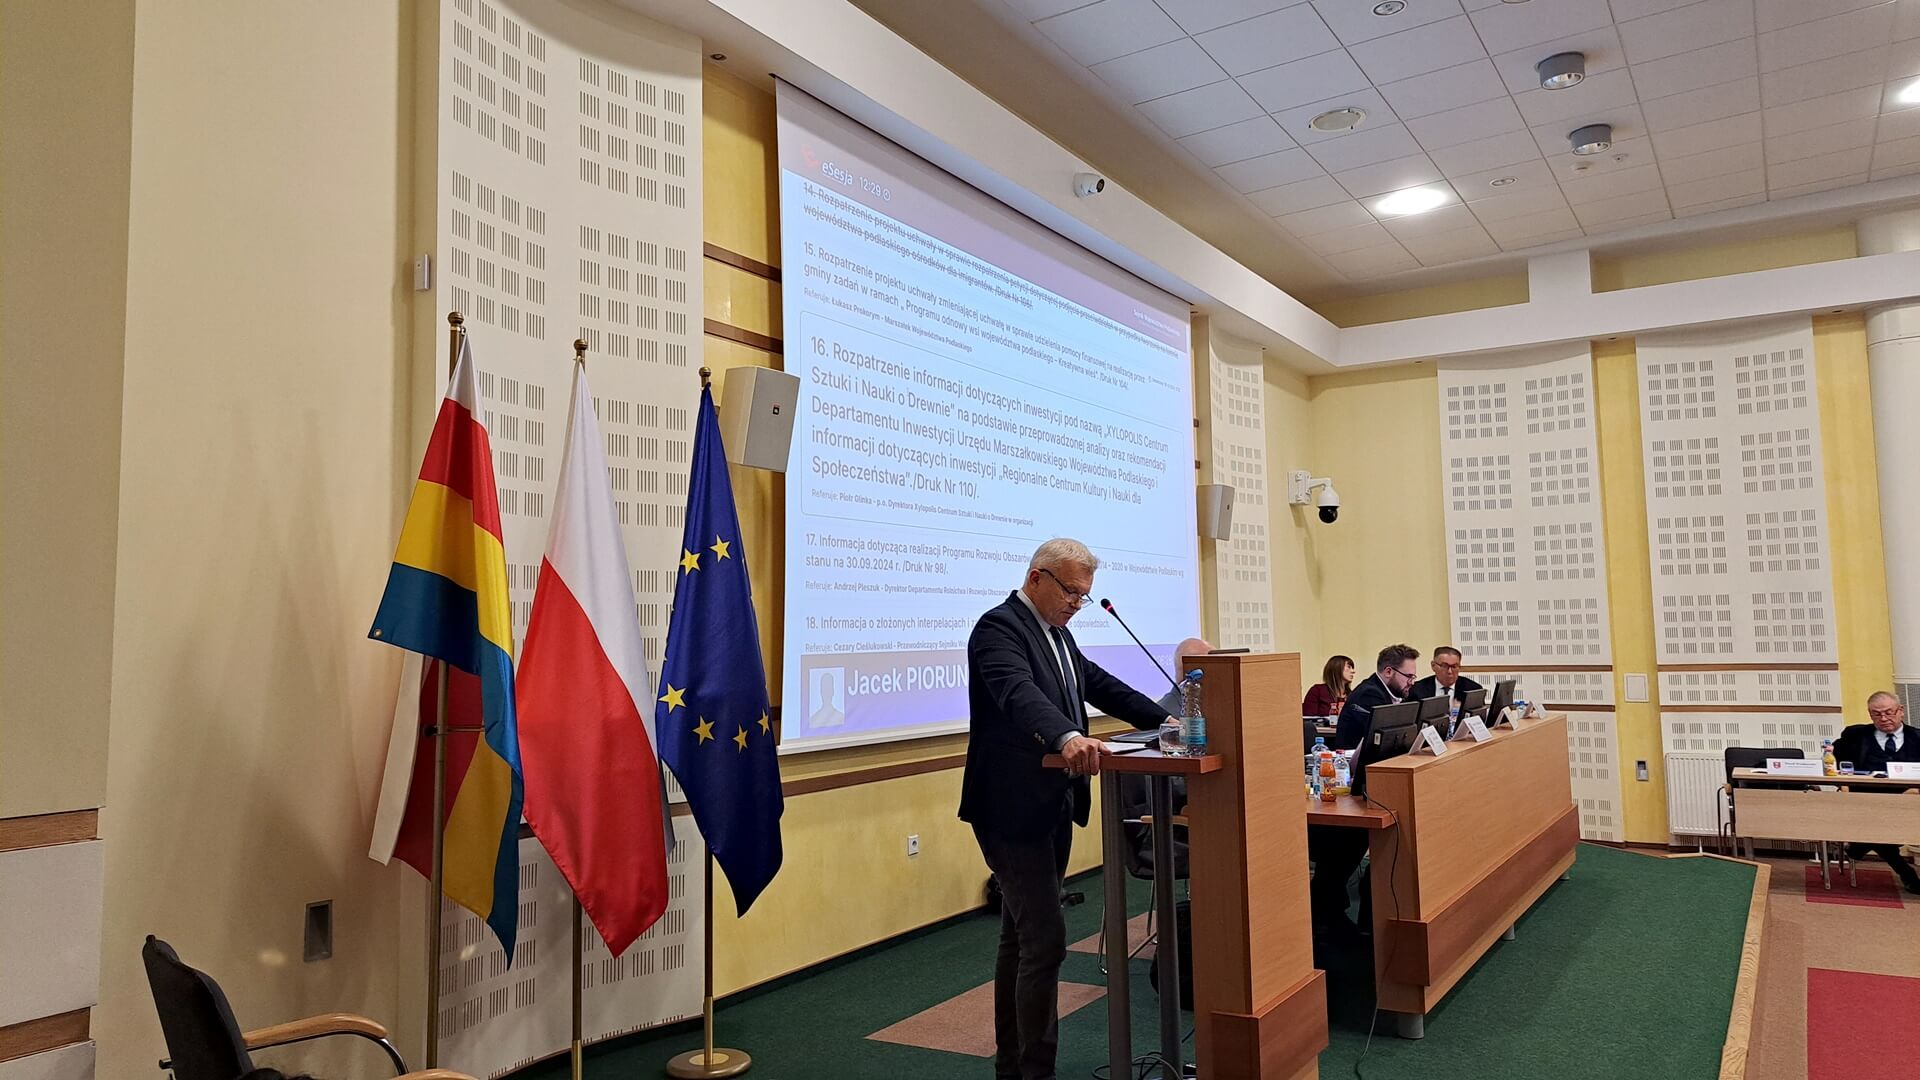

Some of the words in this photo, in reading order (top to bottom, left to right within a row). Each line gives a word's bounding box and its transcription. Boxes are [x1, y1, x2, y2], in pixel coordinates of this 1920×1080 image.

[822, 161, 853, 186] eSesja
[859, 176, 881, 199] 12:29
[804, 204, 863, 237] województwa
[818, 189, 872, 223] Rozpatrzenie
[875, 217, 906, 239] projektu
[804, 242, 816, 258] 15.
[818, 248, 873, 280] Rozpatrzenie
[875, 272, 906, 292] projektu
[908, 285, 937, 306] uchwały
[939, 297, 979, 322] zmieniającej
[1012, 326, 1034, 341] sprawie
[1062, 345, 1081, 361] pomocy
[804, 264, 831, 285] gminy
[834, 276, 859, 293] zadań
[861, 286, 867, 296] w
[870, 289, 899, 308] ramach
[906, 300, 940, 323] Programu
[942, 315, 968, 335] odnowy
[969, 326, 980, 337] wsi
[981, 330, 1021, 352] województwa
[1022, 345, 1054, 364] podlaskiego
[811, 336, 829, 358] 16.
[834, 343, 911, 381] Rozpatrzenie
[913, 367, 963, 398] informacji
[966, 382, 1022, 412] dotyczących
[1024, 400, 1063, 426] inwestycji
[1065, 414, 1079, 428] pod
[1080, 419, 1103, 437] nazwą
[1144, 435, 1169, 453] Centrum
[812, 367, 852, 393] Sztuki
[862, 380, 895, 404] Nauki
[898, 393, 906, 406] o
[958, 409, 969, 423] na
[972, 413, 1018, 435] podstawie
[1020, 425, 1085, 454] przeprowadzonej
[1087, 443, 1110, 460] analizy
[1112, 449, 1126, 462] oraz
[1127, 452, 1167, 473] rekomendacji
[812, 396, 900, 432] Departamentu
[903, 418, 955, 446] Inwestycji
[958, 431, 991, 452] Urzędu
[994, 440, 1068, 470] Marszałkowskiego
[1069, 457, 1117, 480] Województwa
[1119, 469, 1156, 489] Podlaskiego
[812, 426, 875, 457] informacji
[879, 440, 947, 469] dotyczących
[950, 455, 997, 480] inwestycji
[1050, 475, 1082, 494] Centrum
[1083, 482, 1108, 501] Kultury
[1113, 488, 1131, 503] Nauki
[1132, 492, 1142, 505] dla
[840, 493, 854, 502] Piotr
[945, 479, 956, 495] Nr
[959, 481, 980, 501] 110/.
[806, 533, 817, 546] 17.
[820, 534, 865, 552] Informacja
[868, 539, 908, 555] dotycząca
[910, 544, 941, 558] realizacji
[943, 546, 975, 560] Programu
[976, 549, 1002, 563] Rozwoju
[806, 554, 831, 567] stanu
[834, 558, 844, 568] na
[847, 557, 894, 571] 30.09.2024
[902, 561, 923, 574] /Druk
[925, 562, 934, 574] Nr
[806, 617, 818, 629] 18.
[821, 617, 867, 632] Informacja
[869, 620, 875, 629] o
[876, 617, 916, 631] złożonych
[917, 618, 966, 631] interpelacjach
[834, 644, 855, 653] Cezary
[848, 668, 903, 697] Jacek
